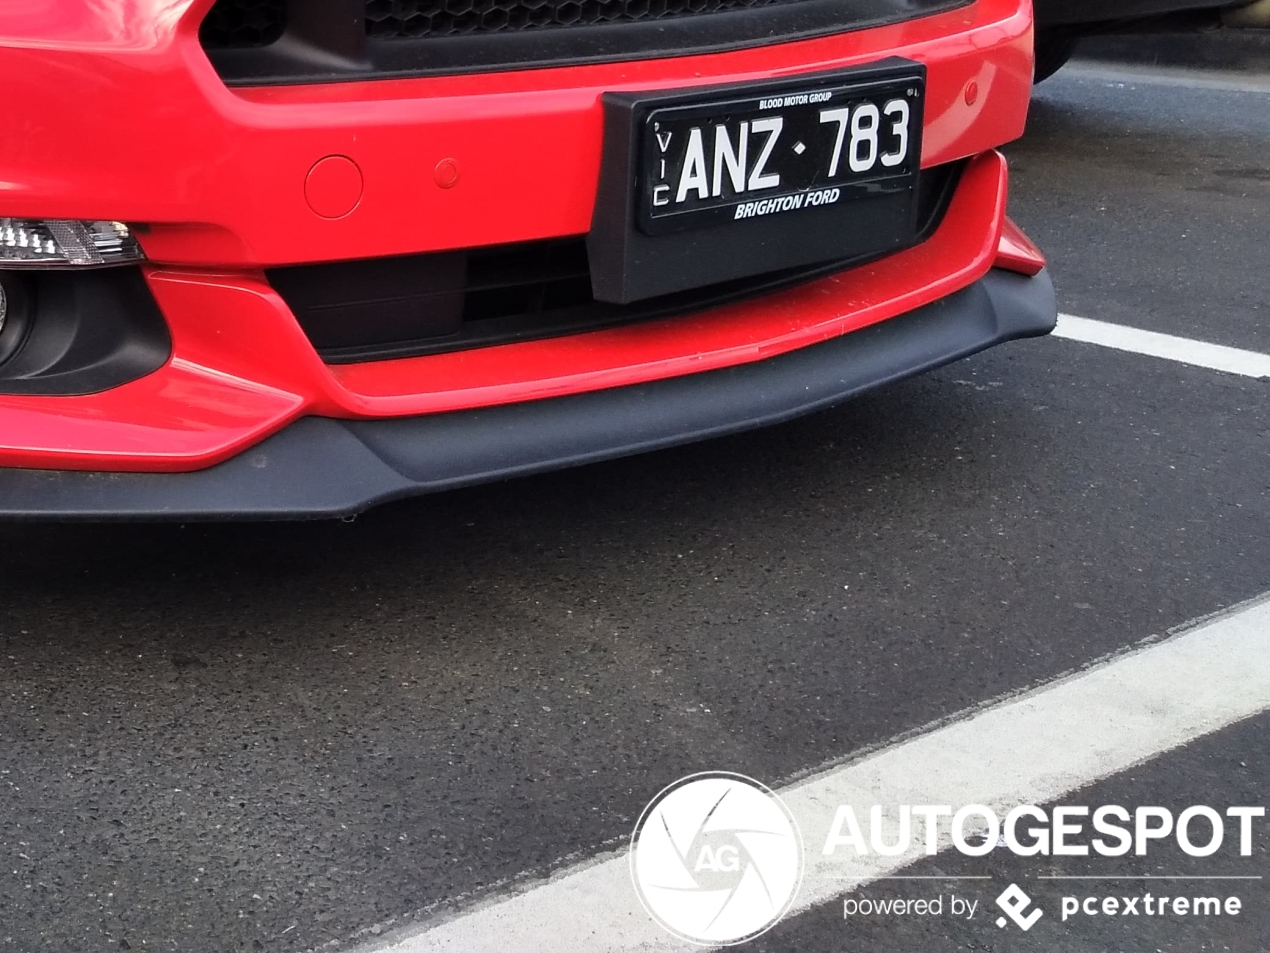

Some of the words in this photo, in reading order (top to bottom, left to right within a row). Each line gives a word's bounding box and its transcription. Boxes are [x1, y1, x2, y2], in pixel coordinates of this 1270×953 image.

[759, 97, 783, 110] BLOOD
[784, 94, 808, 107] MOTOR
[809, 91, 832, 105] GROUP
[653, 131, 673, 207] VIC
[675, 117, 785, 203] ANZ
[819, 99, 910, 177] 783
[734, 194, 803, 220] BRIGHTON
[804, 188, 840, 207] FORD
